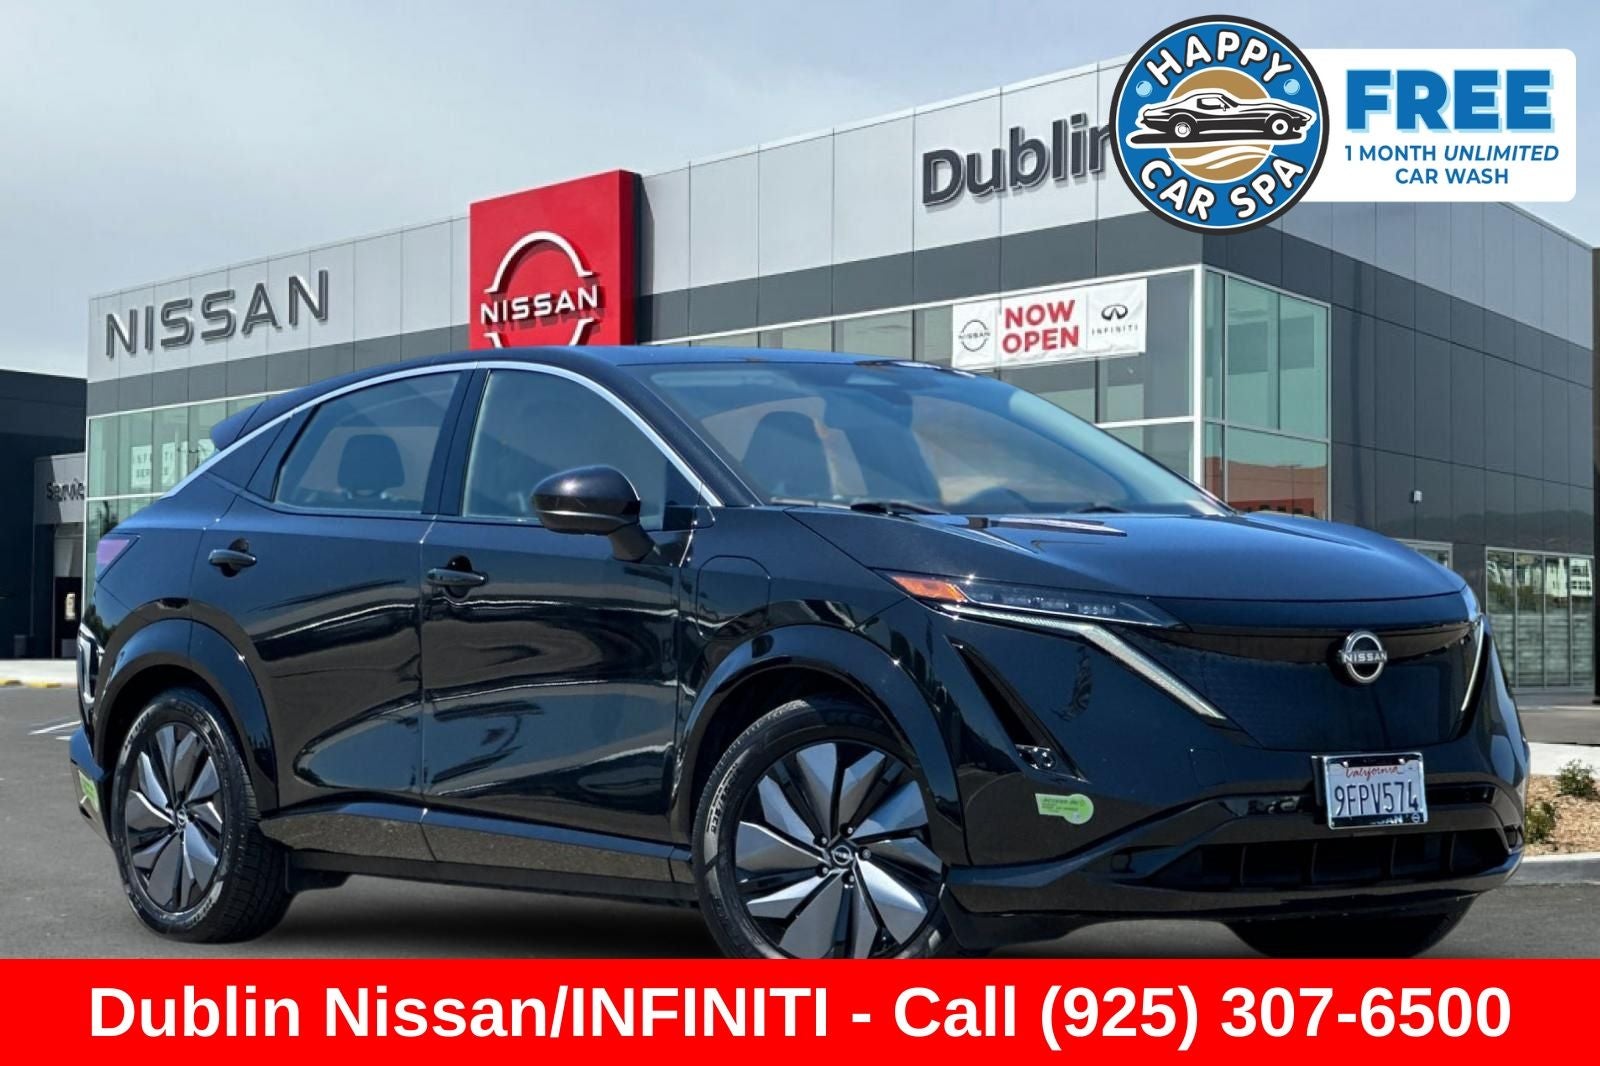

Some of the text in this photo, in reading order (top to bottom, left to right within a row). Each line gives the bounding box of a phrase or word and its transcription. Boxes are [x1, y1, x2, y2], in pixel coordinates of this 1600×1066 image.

[106, 270, 328, 360] NISSAN
[480, 285, 598, 325] NISSAN
[1004, 300, 1076, 329] NOW
[1002, 326, 1080, 353] OPEN
[1091, 324, 1139, 336] INFINITI
[1342, 651, 1388, 663] NISSAN
[1334, 781, 1419, 816] 9FPV574
